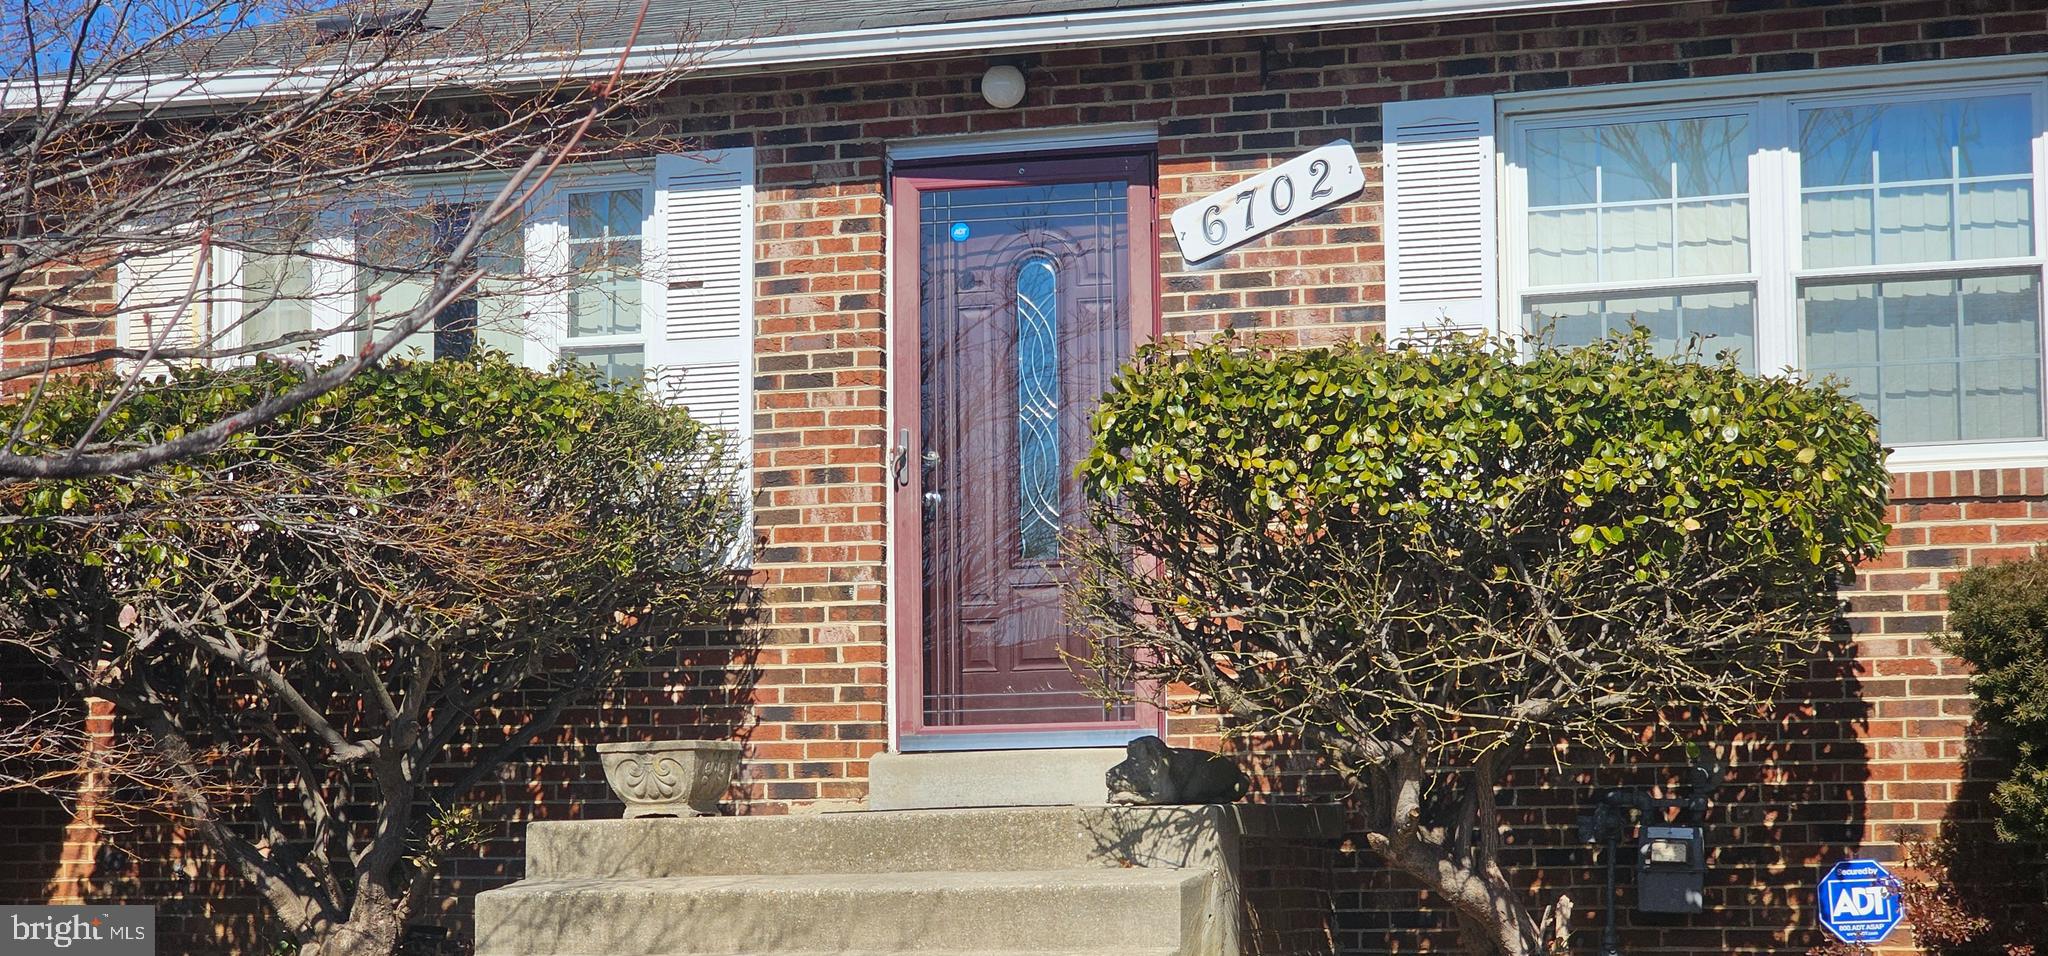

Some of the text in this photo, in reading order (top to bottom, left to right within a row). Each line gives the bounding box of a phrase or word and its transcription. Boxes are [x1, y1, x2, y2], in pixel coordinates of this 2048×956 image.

[1202, 159, 1333, 246] 6702
[1837, 866, 1878, 876] Secured by
[1833, 886, 1887, 916] ADT
